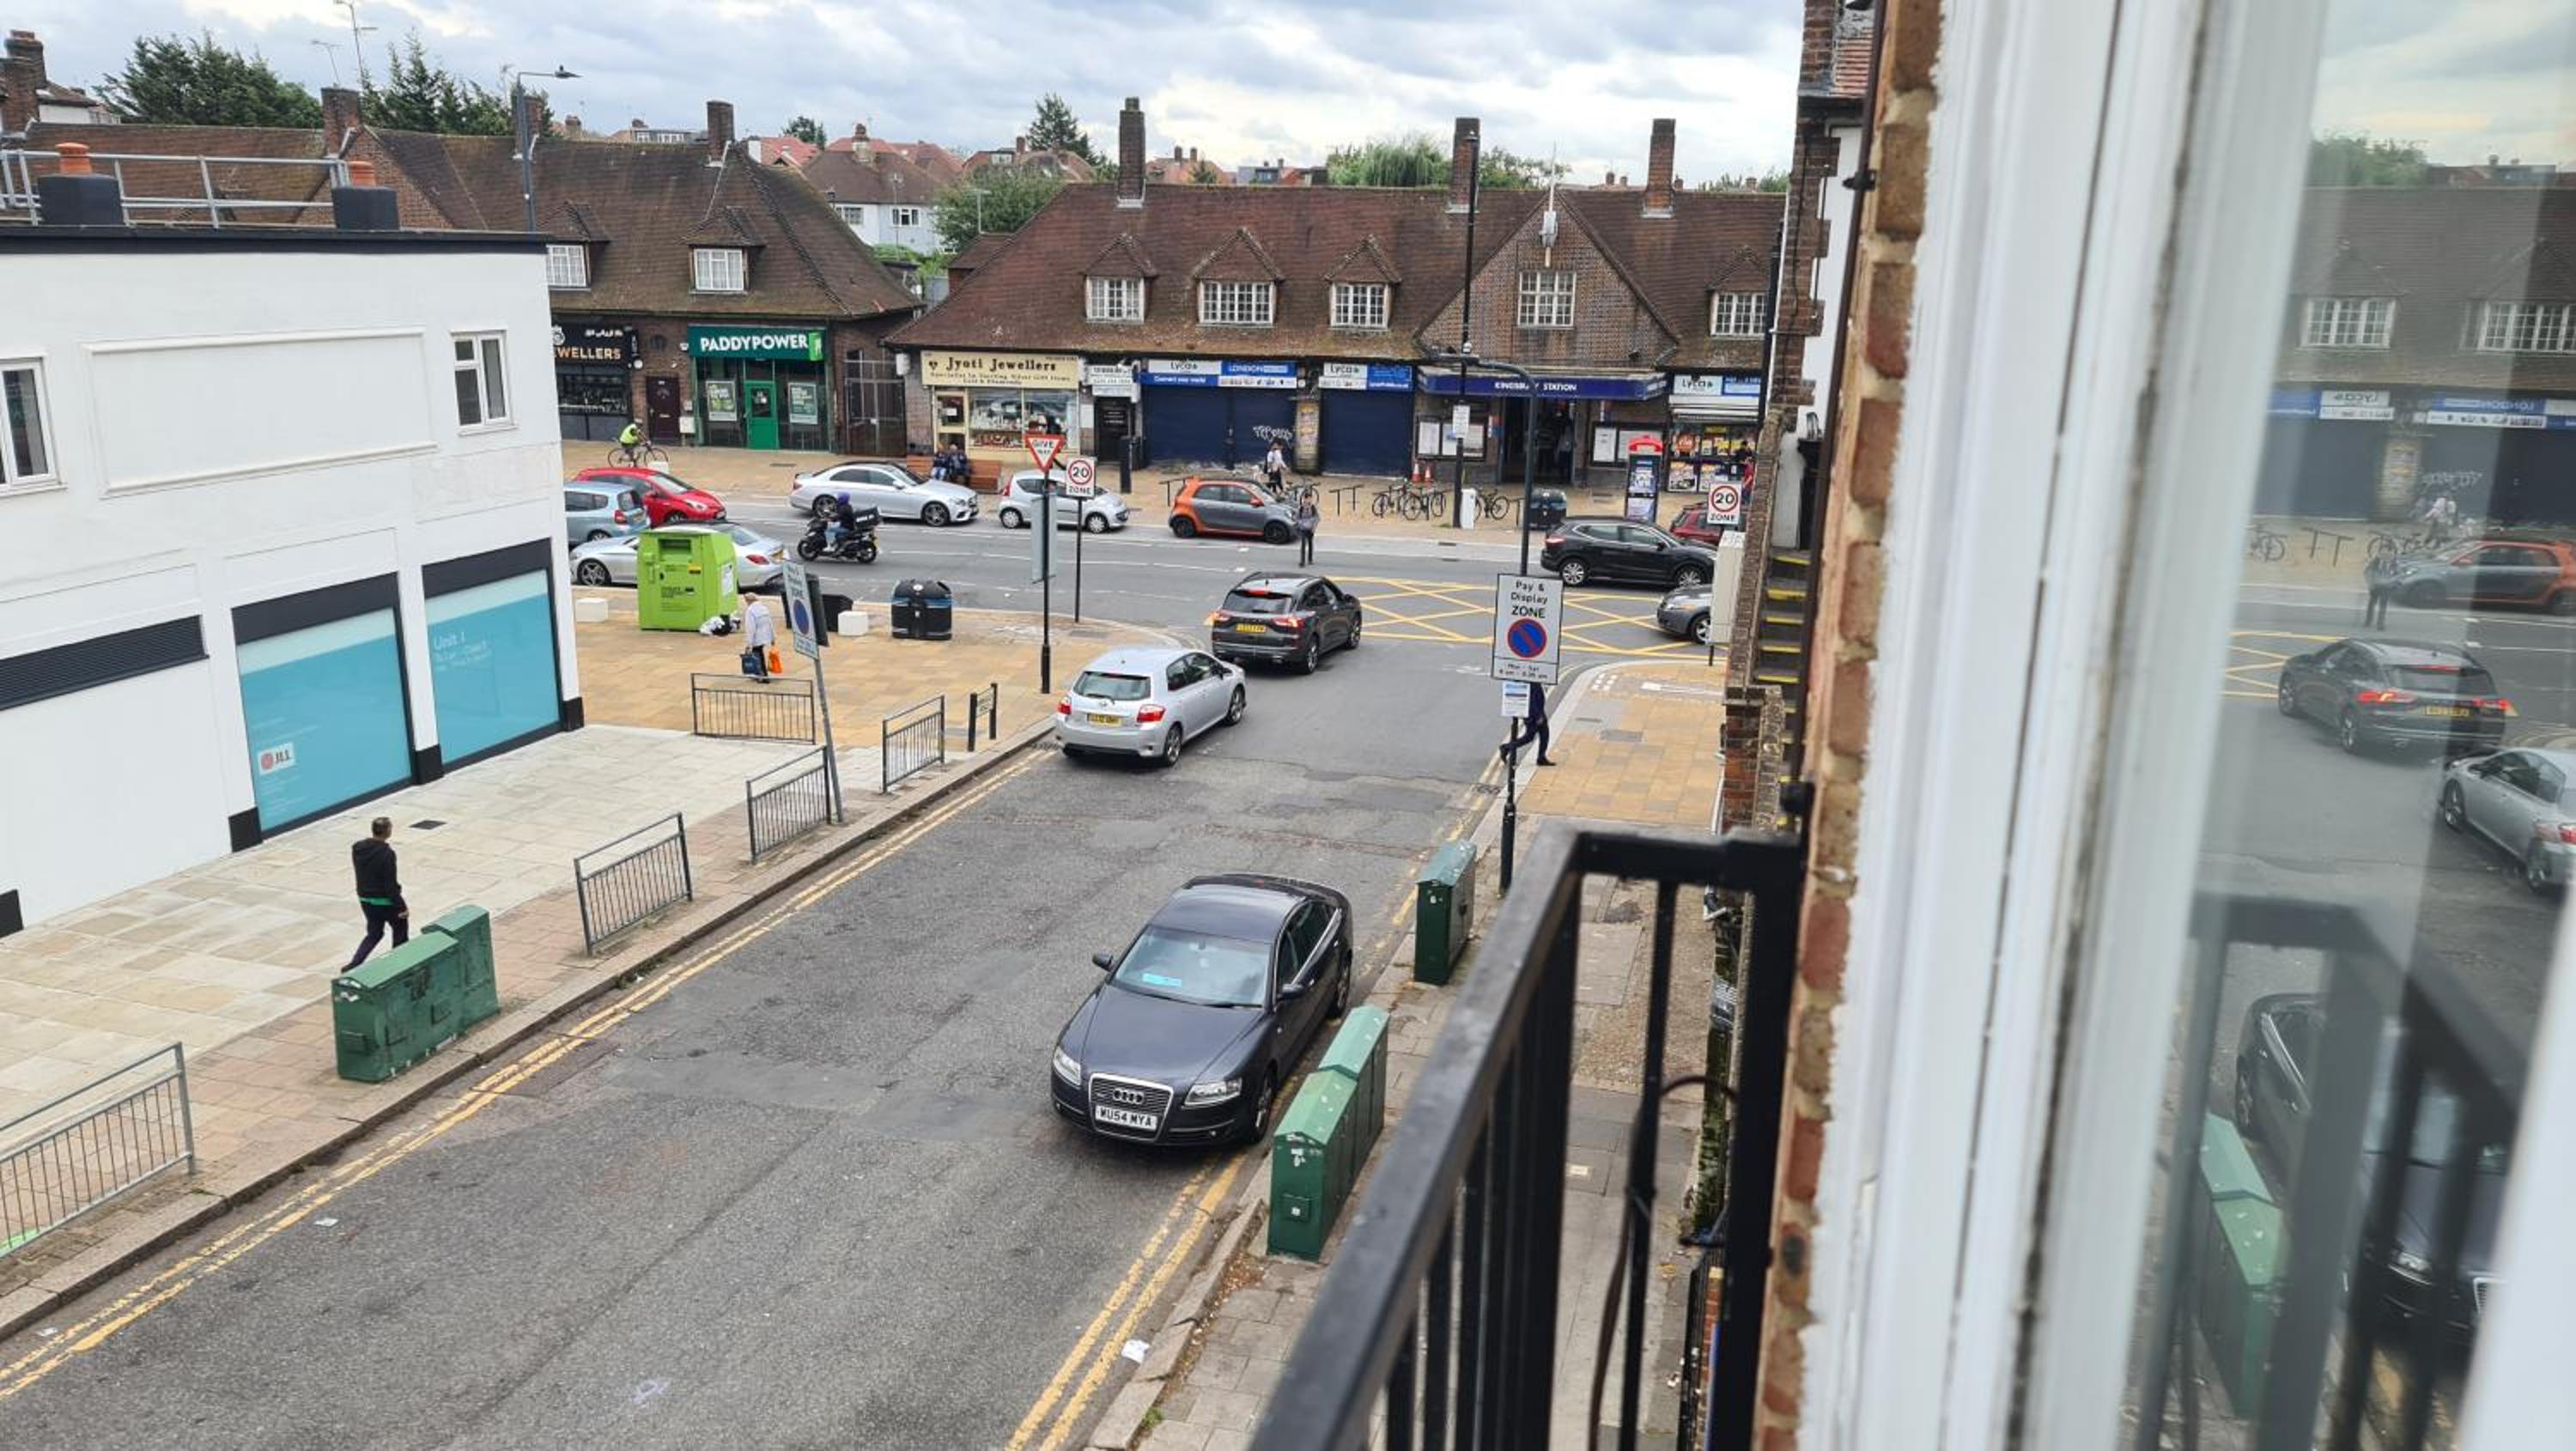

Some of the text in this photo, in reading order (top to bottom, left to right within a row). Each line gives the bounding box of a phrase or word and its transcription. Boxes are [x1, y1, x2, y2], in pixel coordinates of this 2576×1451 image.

[700, 333, 809, 352] PADDYPOWER
[554, 346, 621, 360] WELLERS
[945, 356, 1056, 373] Jyoti Jewellers
[1543, 383, 1577, 392] STATION
[1033, 439, 1054, 448] GIVE
[1072, 466, 1090, 478] 20
[1068, 485, 1092, 495] ZONE
[1715, 492, 1735, 504] 20
[1516, 580, 1545, 592] Pay &
[1510, 592, 1548, 604] Display
[1510, 604, 1546, 619] ZONE
[1129, 1114, 1151, 1126] MYA
